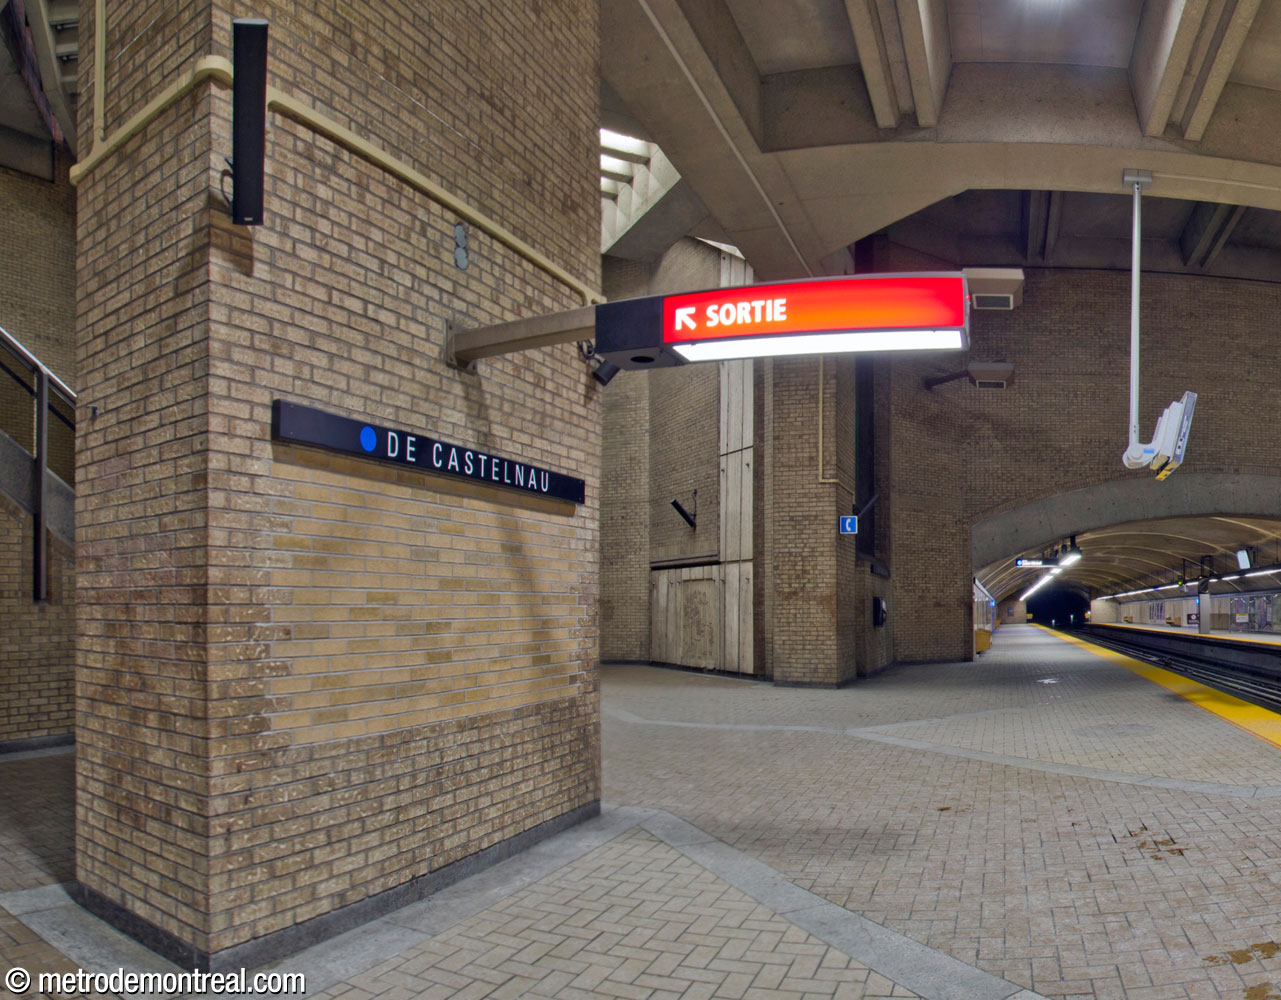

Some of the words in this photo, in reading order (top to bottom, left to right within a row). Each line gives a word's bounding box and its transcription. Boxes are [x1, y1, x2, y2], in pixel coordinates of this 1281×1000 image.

[706, 298, 787, 327] SORTIE
[387, 431, 416, 462] DE
[432, 442, 549, 492] CASTELNAU
